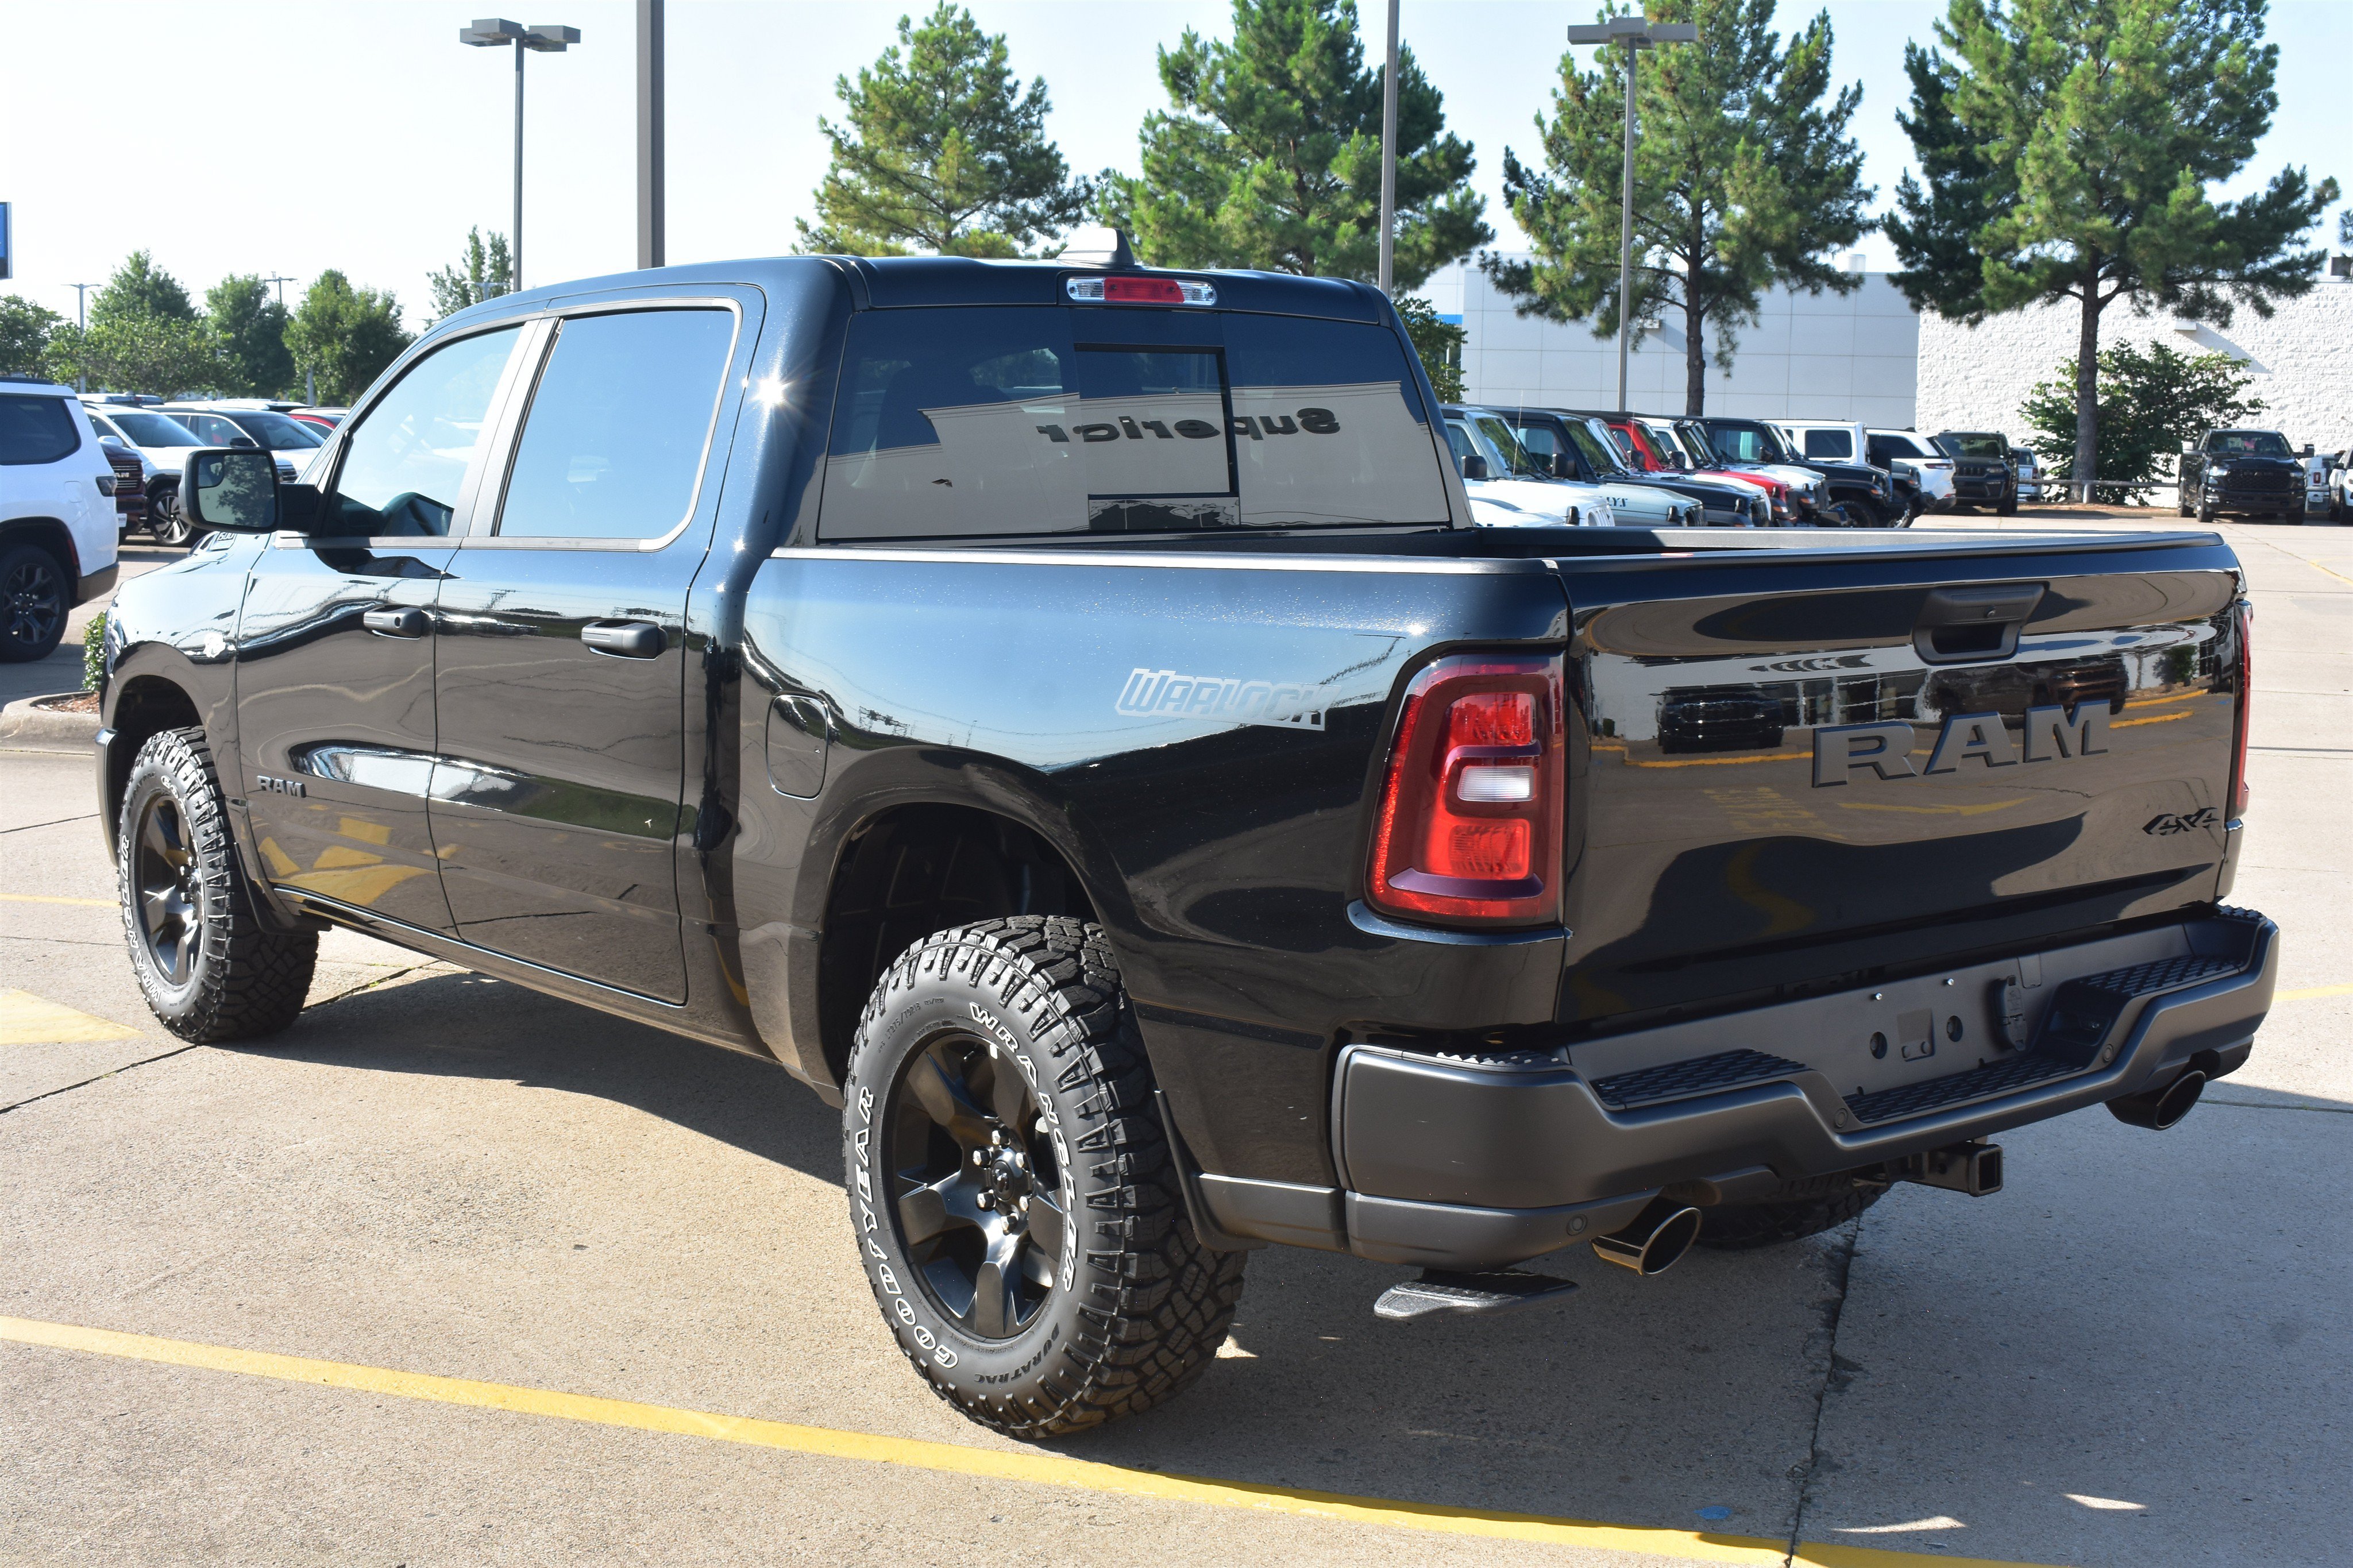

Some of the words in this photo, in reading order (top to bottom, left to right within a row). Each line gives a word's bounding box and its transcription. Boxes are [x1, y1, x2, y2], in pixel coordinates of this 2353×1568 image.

[1114, 667, 1341, 731] WARLOCK
[1812, 698, 2111, 788] RAM
[257, 775, 307, 798] RAM
[121, 834, 164, 1002] WRANGLER
[970, 1002, 1078, 1292] WRANGLER
[855, 1087, 959, 1369] GOODYEAR
[974, 1322, 1060, 1385] DURATRAC
